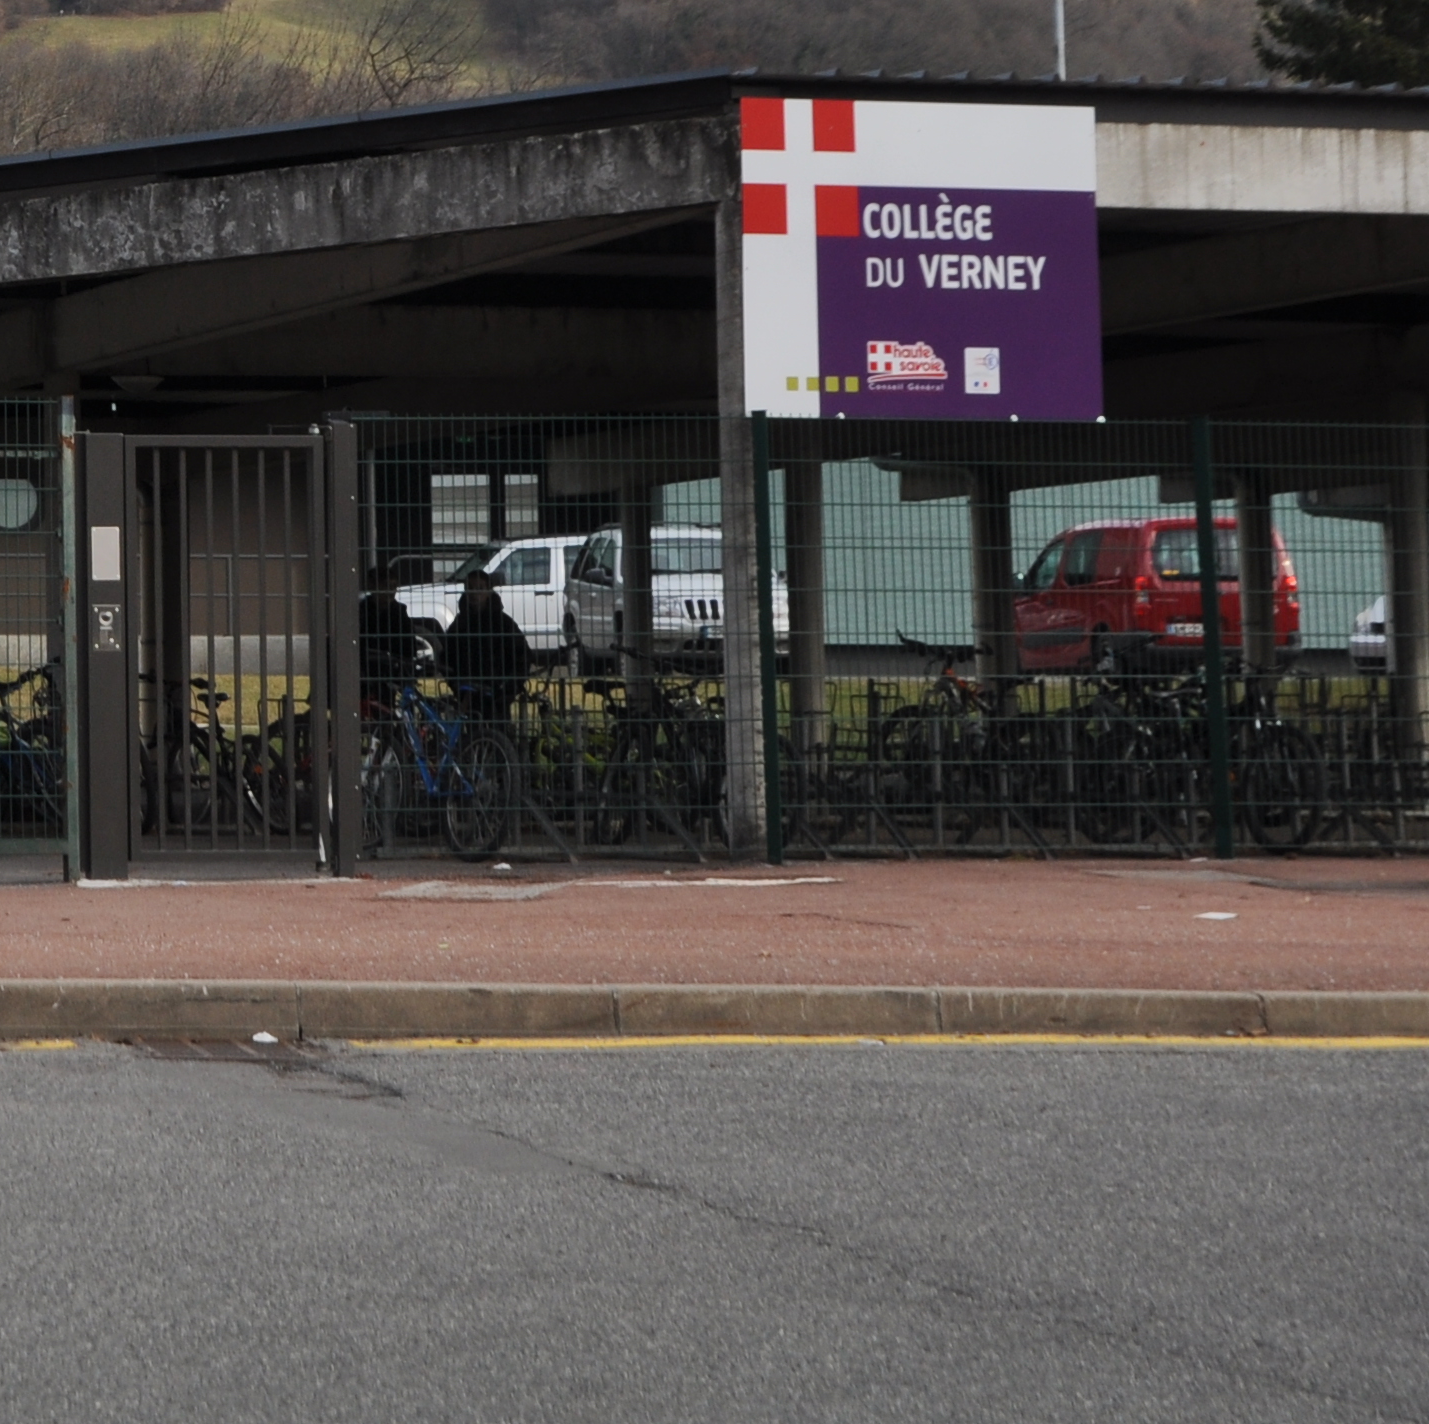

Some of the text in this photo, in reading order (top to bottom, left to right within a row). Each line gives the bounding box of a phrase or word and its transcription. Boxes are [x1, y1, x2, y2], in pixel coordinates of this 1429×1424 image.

[863, 192, 993, 240] COLLÈGE
[865, 254, 1047, 290] DU VERNEY
[894, 344, 931, 358] haute
[900, 360, 942, 372] savoie
